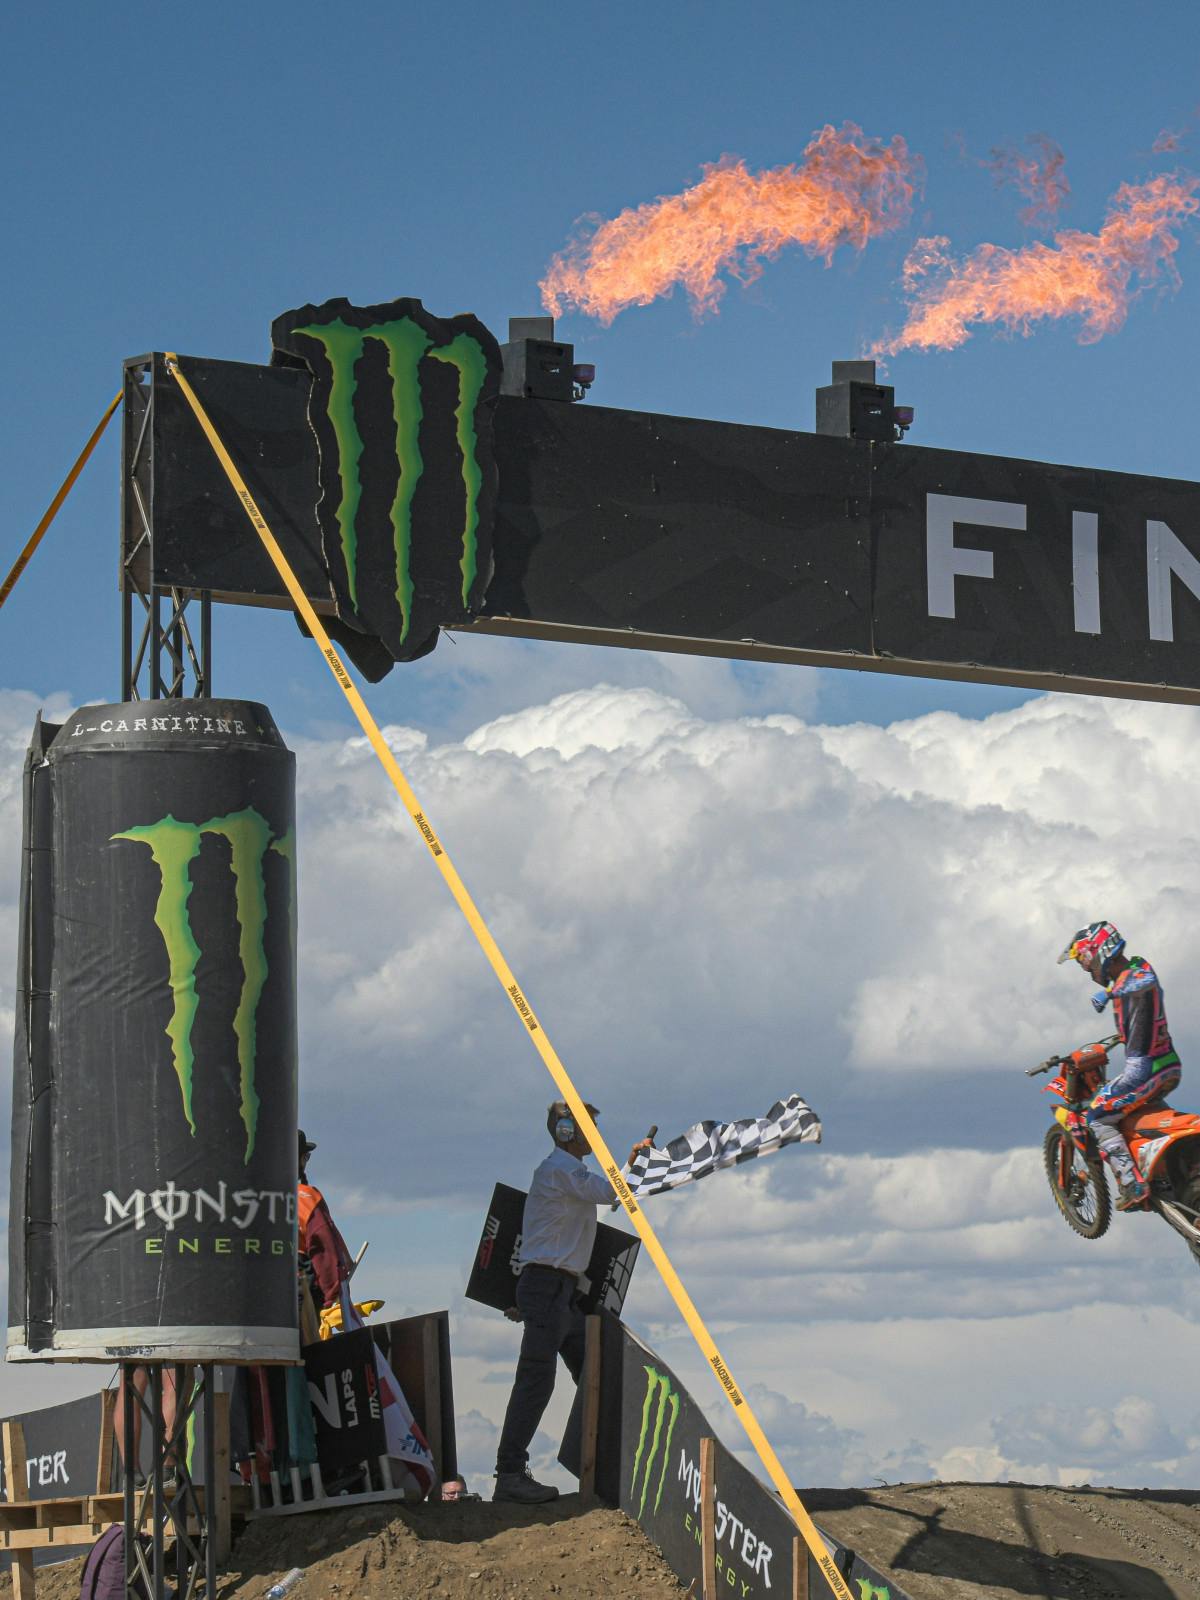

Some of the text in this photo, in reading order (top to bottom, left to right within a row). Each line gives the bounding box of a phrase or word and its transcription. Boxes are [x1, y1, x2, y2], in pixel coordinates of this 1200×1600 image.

[71, 714, 247, 736] L-CARNITINE
[710, 1355, 735, 1391] KINEDYNE
[341, 1368, 359, 1428] LAPS
[678, 1448, 773, 1589] MOSTER
[685, 1513, 750, 1597] ENRGY
[820, 1555, 845, 1593] KINEDYNE
